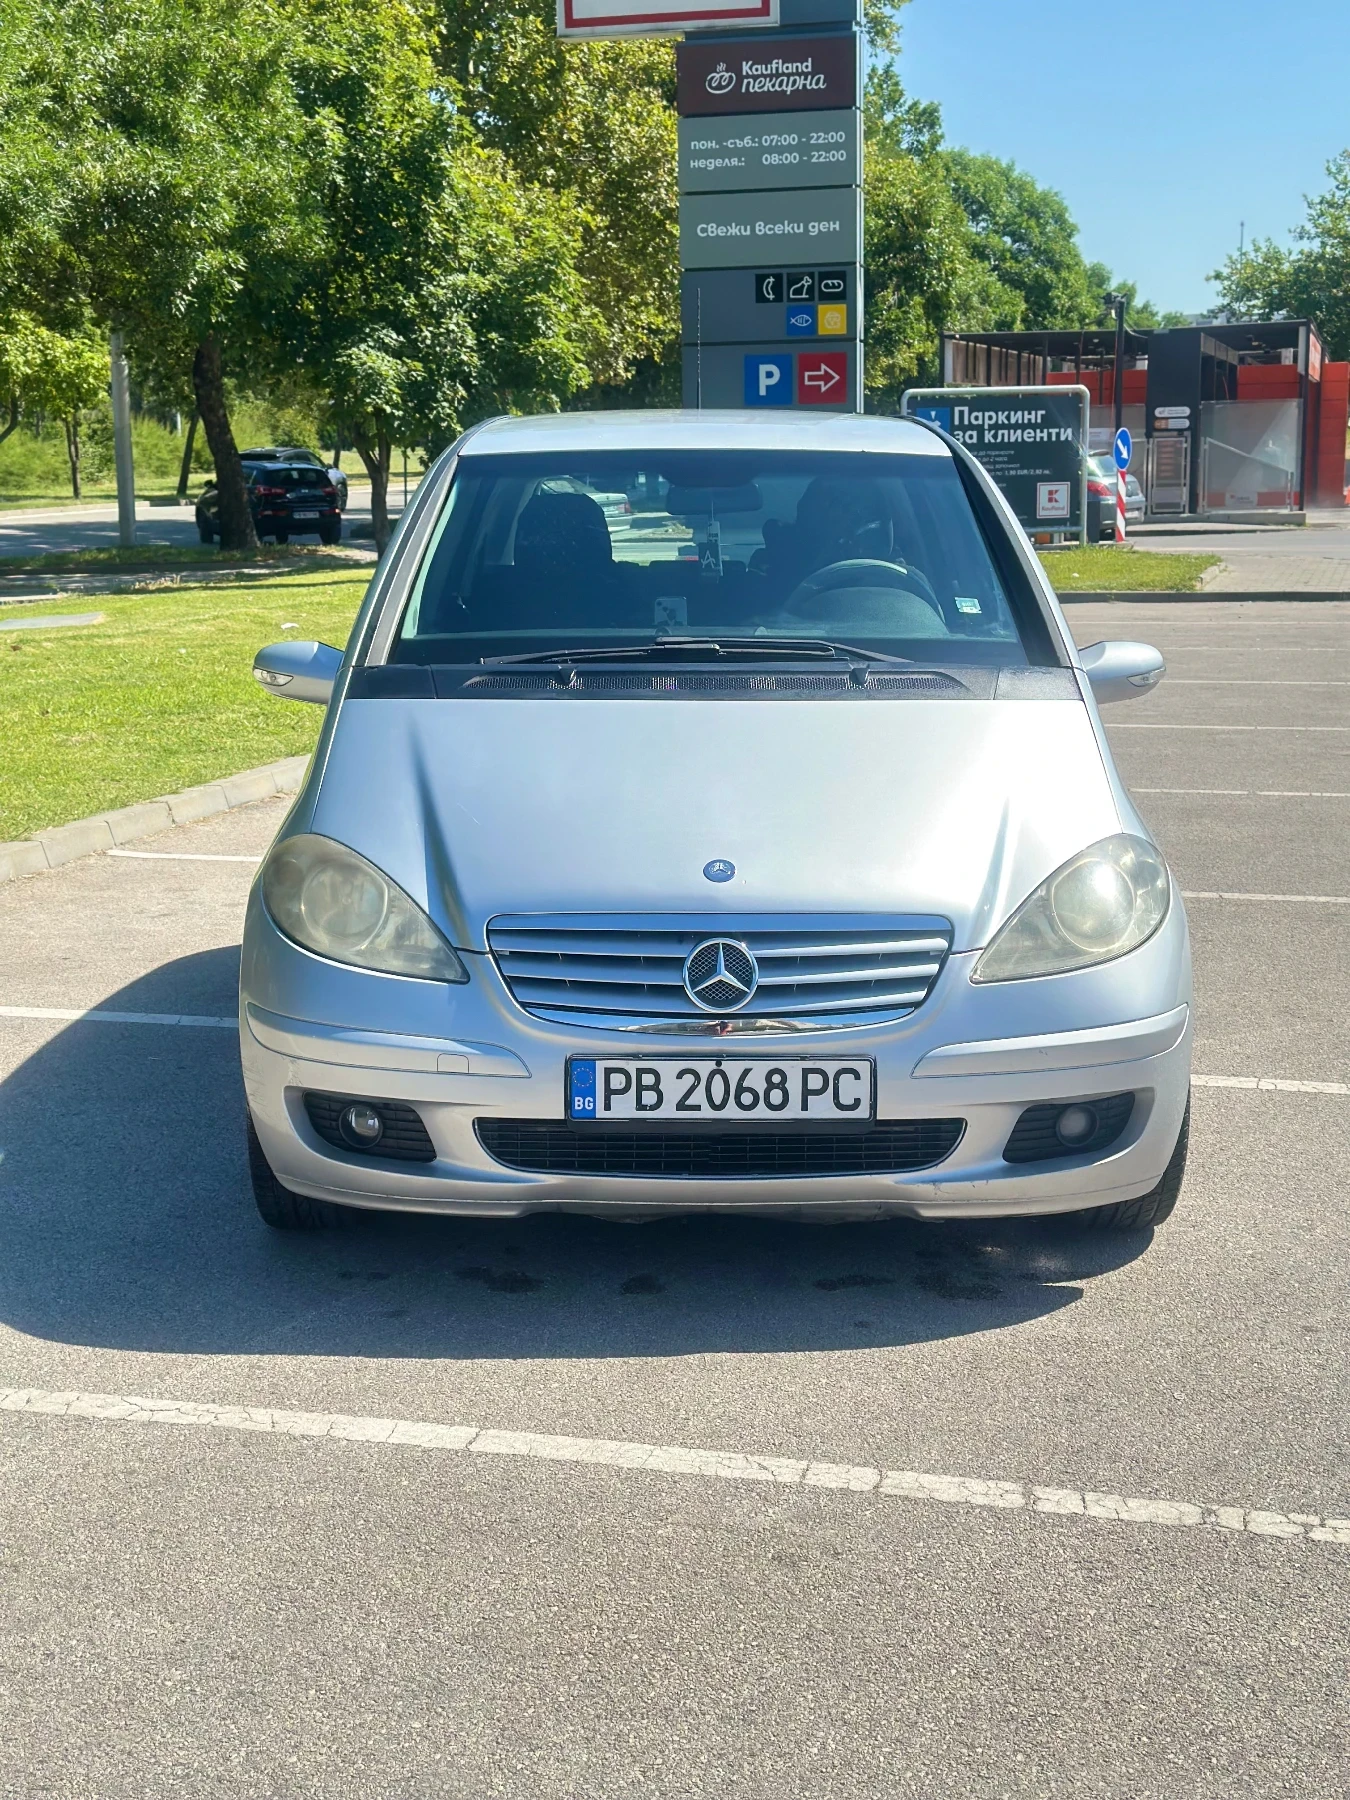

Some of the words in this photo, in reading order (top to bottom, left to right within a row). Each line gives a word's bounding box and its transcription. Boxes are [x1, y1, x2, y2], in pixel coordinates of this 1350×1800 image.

[742, 57, 812, 76] Kaufland
[741, 74, 827, 95] пекарна
[690, 139, 720, 150] пон.
[761, 133, 798, 146] 07:00
[809, 131, 846, 144] 22:00
[690, 156, 746, 170] неделя.:
[761, 152, 800, 165] 08:00
[810, 149, 847, 163] 22:00
[696, 222, 751, 237] Свежи
[755, 219, 804, 235] всеки
[808, 220, 840, 236] ден
[758, 363, 781, 396] P
[953, 406, 1046, 429] Паркинг
[953, 430, 978, 444] за
[983, 427, 1073, 444] клиенти
[603, 1067, 664, 1112] PB
[675, 1067, 790, 1112] 2068
[801, 1067, 862, 1112] PC
[574, 1096, 594, 1111] BG
